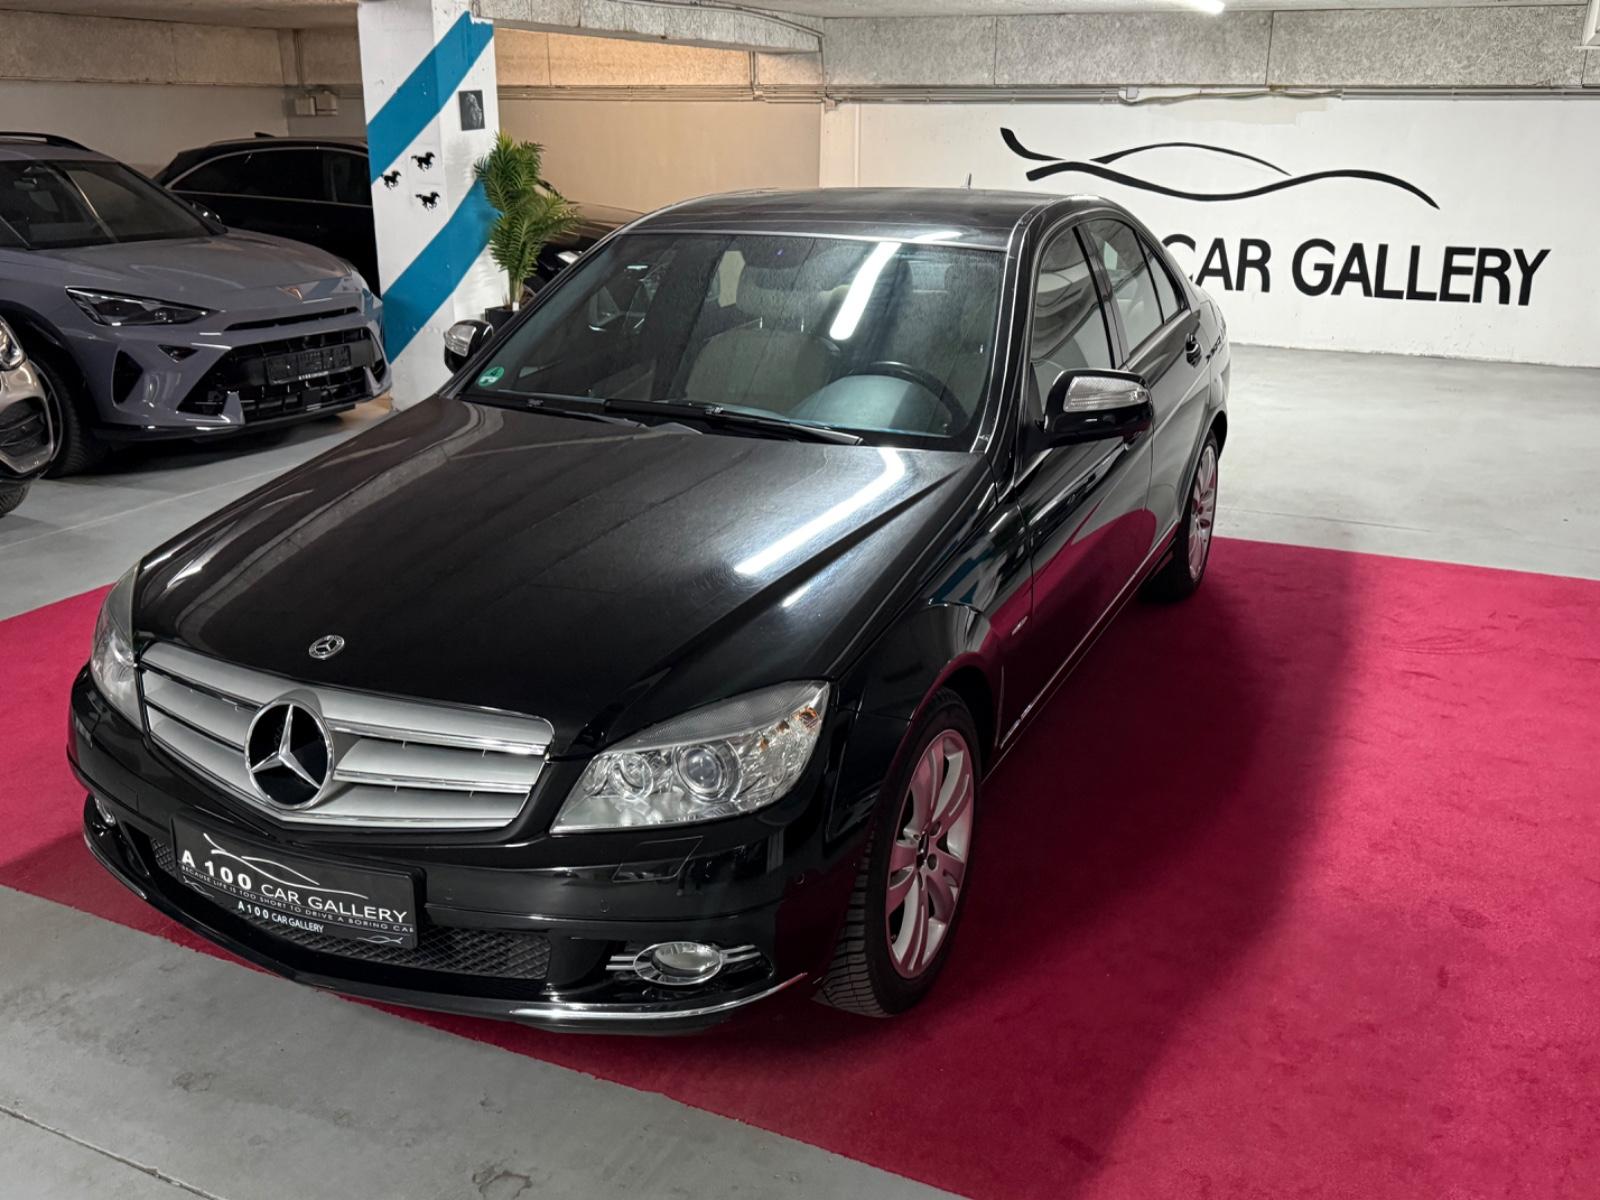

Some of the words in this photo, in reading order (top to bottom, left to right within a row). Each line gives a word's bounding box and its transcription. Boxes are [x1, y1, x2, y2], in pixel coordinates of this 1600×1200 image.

[1292, 238, 1551, 306] GALLERY
[182, 850, 196, 868] A
[205, 861, 252, 890] 100
[261, 884, 302, 905] CAR
[308, 896, 408, 923] GALLERY
[260, 897, 286, 908] SHORT
[290, 903, 302, 913] TO
[306, 910, 333, 920] DRIVE
[348, 918, 388, 929] BORING
[271, 912, 288, 925] CAR
[288, 918, 324, 933] GALLERY
